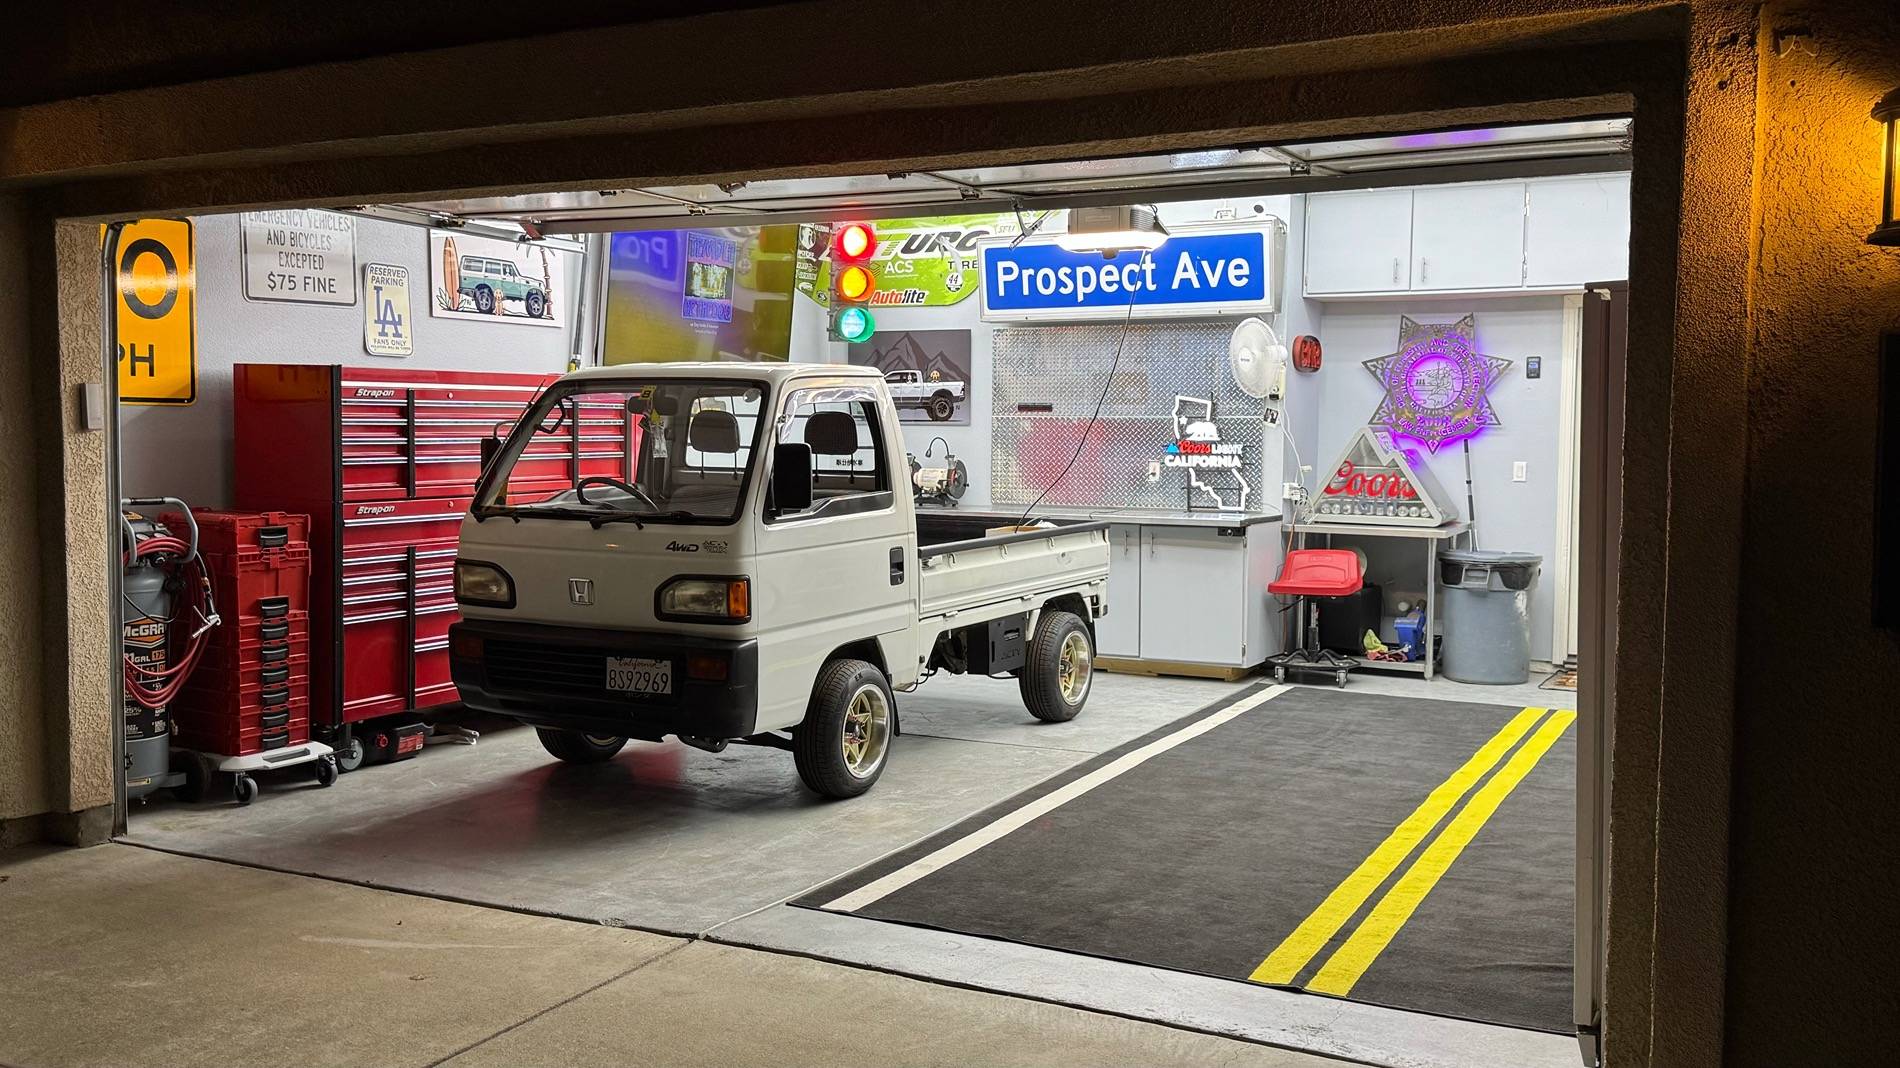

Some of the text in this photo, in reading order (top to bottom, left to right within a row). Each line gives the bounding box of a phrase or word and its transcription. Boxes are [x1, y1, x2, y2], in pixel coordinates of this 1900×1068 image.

[248, 210, 350, 232] EMERGENCY VEHICLES
[266, 229, 332, 251] AND BICYCLES
[278, 251, 325, 271] EXCEPTED
[884, 261, 914, 273] ACS
[948, 260, 978, 270] TRE
[369, 266, 406, 279] RESERVED
[997, 251, 1250, 303] Prospect Ave
[267, 271, 337, 294] $75 FINE
[371, 276, 404, 287] PARKING
[871, 290, 926, 305] Autolite
[373, 285, 403, 339] LA
[373, 338, 407, 347] FANS ONLY
[356, 388, 395, 398] Strap-on
[1178, 440, 1243, 455] Coors LIGHT
[1164, 455, 1242, 468] CALIFORNIA
[1323, 460, 1416, 498] Coors
[357, 505, 395, 515] Strap-on
[665, 541, 699, 552] 4WD
[124, 623, 166, 637] McGRA
[609, 669, 669, 692] 8S92969
